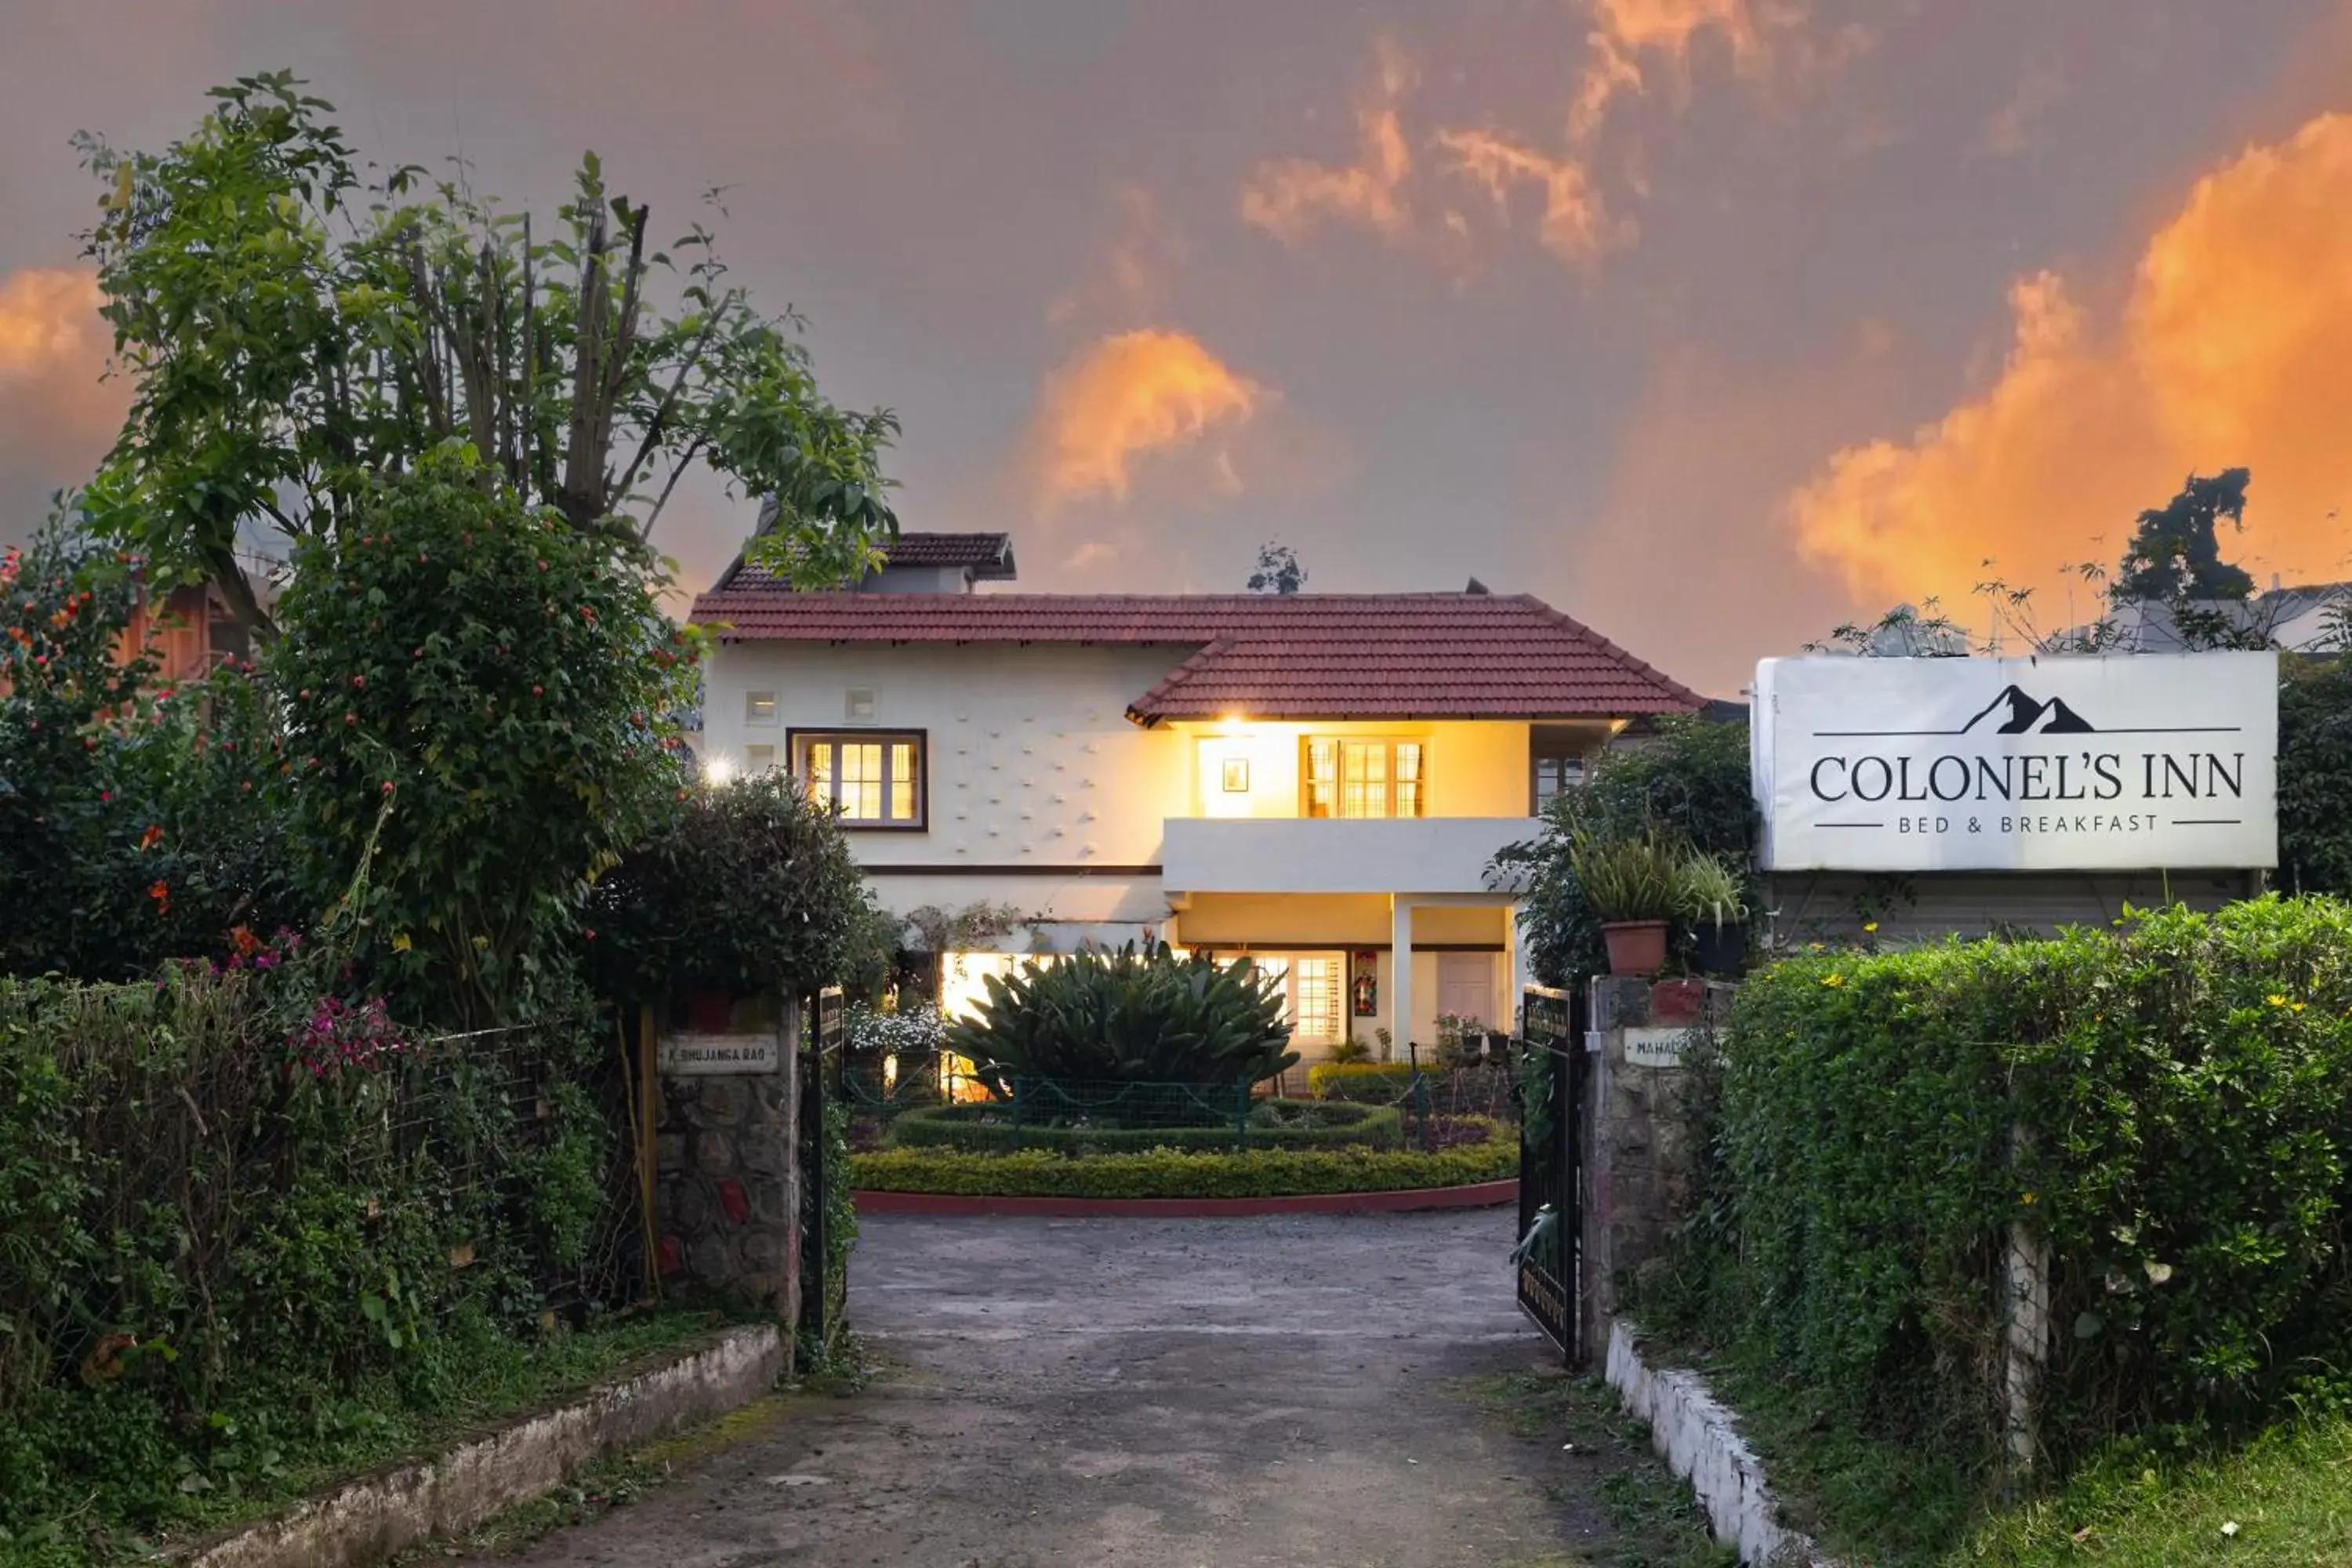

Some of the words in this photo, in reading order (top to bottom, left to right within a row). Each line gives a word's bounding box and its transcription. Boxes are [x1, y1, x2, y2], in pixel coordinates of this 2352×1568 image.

[1809, 751, 2122, 802] COLONEL'S
[2141, 751, 2245, 799] INN
[1899, 817, 1950, 833] BED
[1968, 816, 1982, 833] &
[2001, 815, 2158, 833] BREAKFAST
